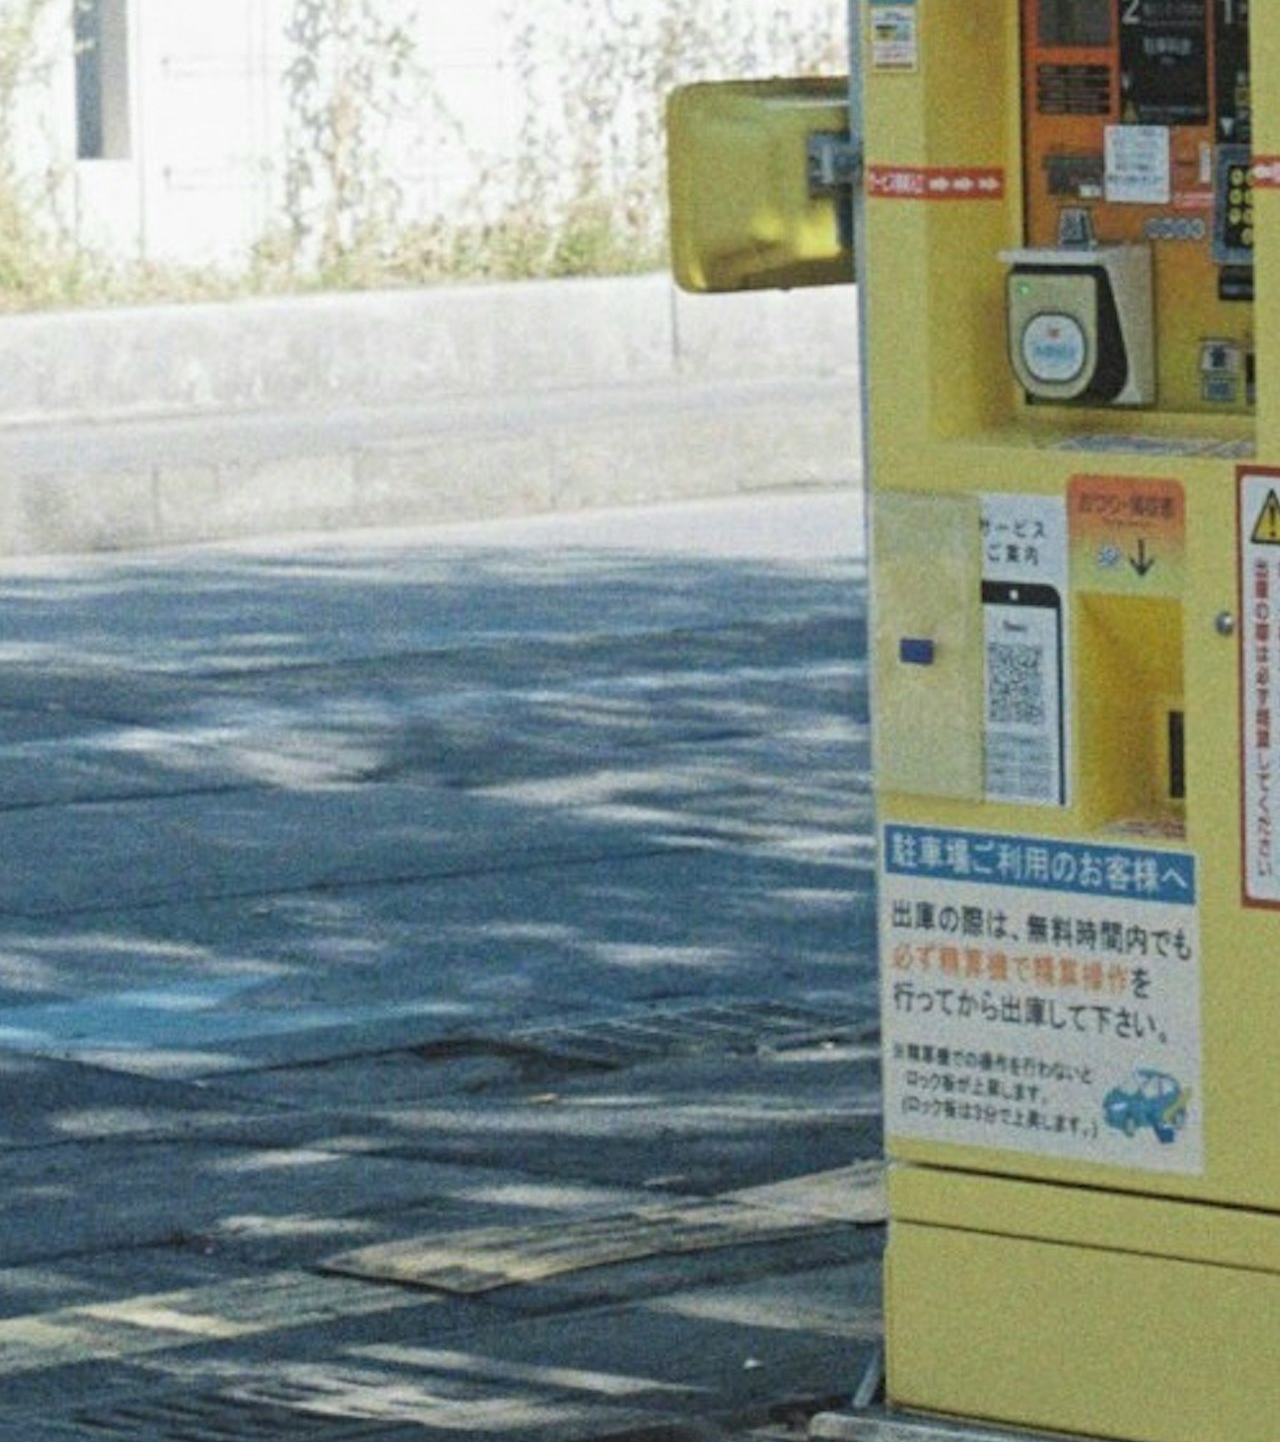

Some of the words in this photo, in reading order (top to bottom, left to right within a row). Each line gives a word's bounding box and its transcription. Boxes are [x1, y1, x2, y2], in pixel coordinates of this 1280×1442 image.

[891, 831, 1188, 892] 駐車場ご利用のお客様へ
[892, 901, 1191, 961] 出庫の際は、無料時間内でも
[893, 982, 1167, 1043] 行ってから出庫して下さい。
